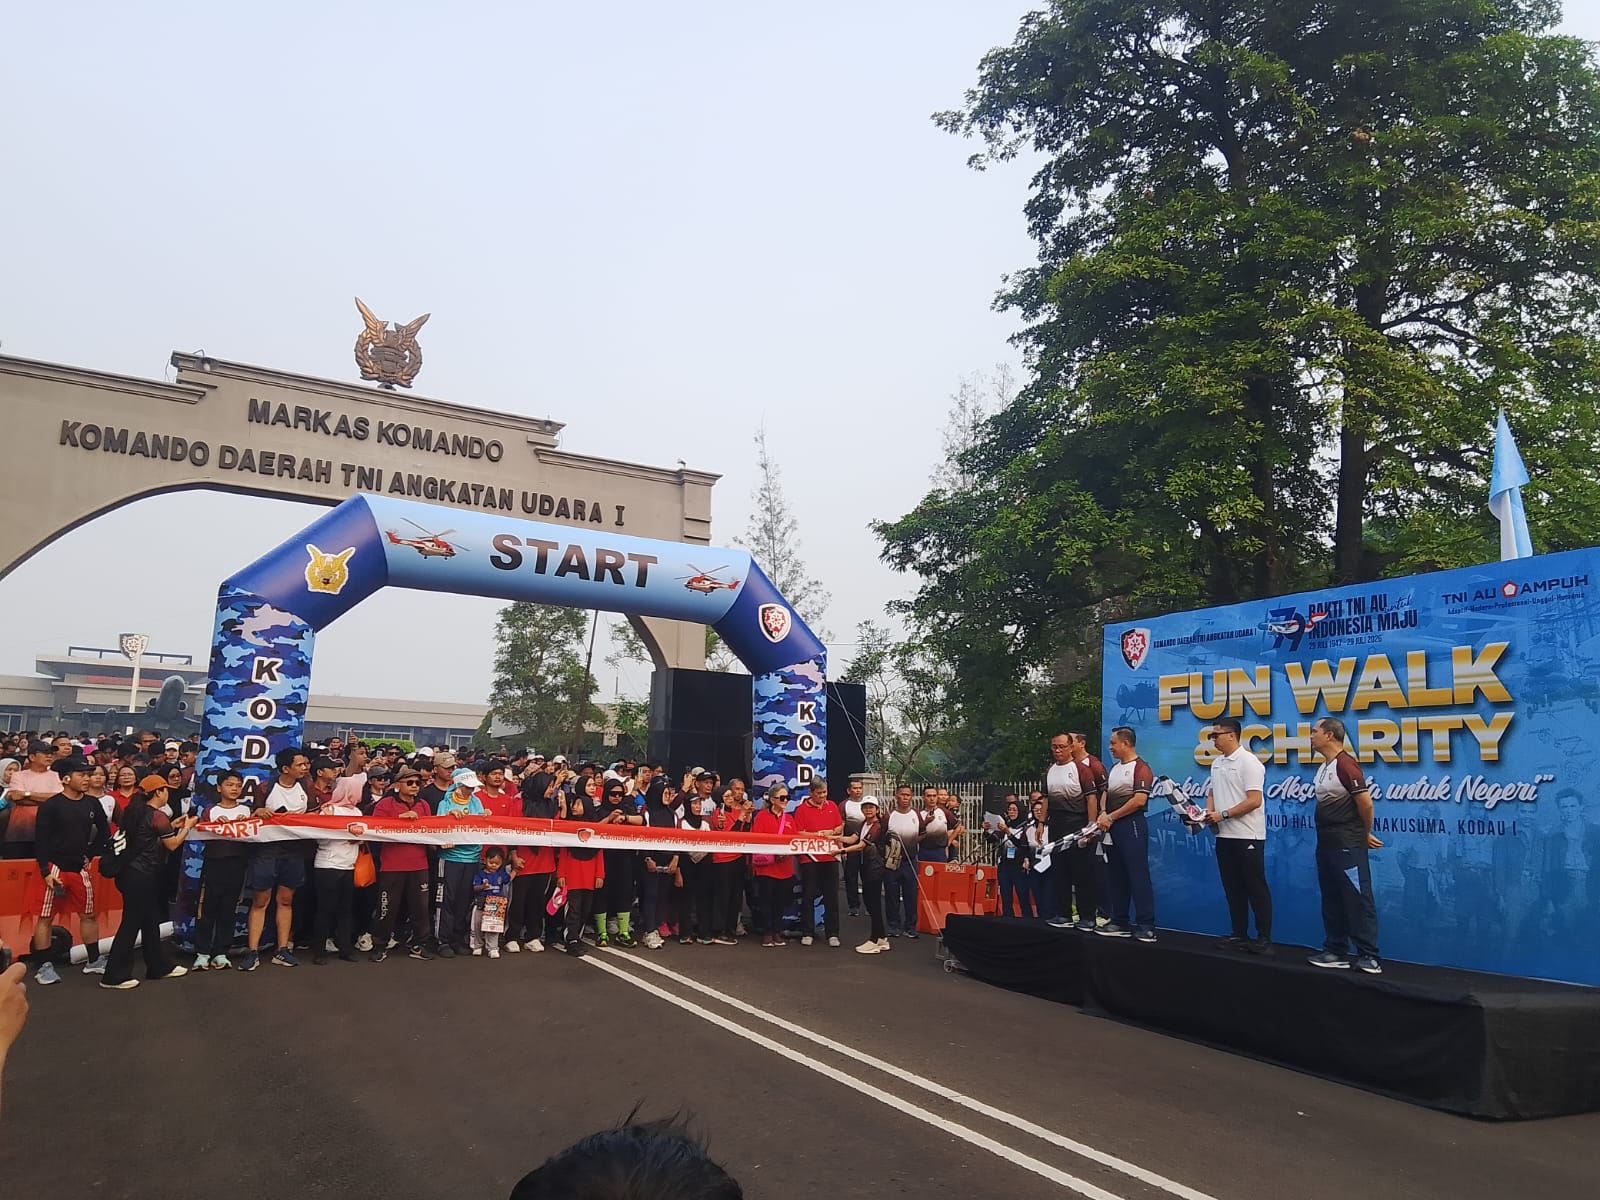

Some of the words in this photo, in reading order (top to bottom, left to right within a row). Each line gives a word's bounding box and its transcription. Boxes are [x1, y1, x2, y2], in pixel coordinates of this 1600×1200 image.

[248, 398, 369, 440] MARKAS
[376, 420, 504, 462] KOMANDO
[59, 419, 210, 467] KOMANDO
[218, 445, 332, 484] DAERAH
[341, 463, 382, 492] TNI
[388, 471, 514, 511] ANGKATAN
[521, 491, 603, 524] UDARA
[614, 504, 626, 526] I
[489, 533, 658, 588] START
[1441, 591, 1467, 605] TNI
[1473, 588, 1497, 601] AU
[1520, 574, 1589, 595] AMPUH
[1346, 597, 1366, 616] TNI
[1370, 593, 1388, 613] AU
[1308, 615, 1373, 640] INDONESIA
[1377, 609, 1418, 632] MAJU
[1158, 664, 1271, 722] FUN
[1284, 641, 1514, 714] WALK
[1386, 775, 1450, 801] untuk
[206, 818, 261, 838] TART
[375, 824, 418, 835] Komando
[420, 824, 453, 834] Daerah
[455, 824, 470, 833] TNI
[471, 825, 514, 836] Angkatan
[1458, 819, 1506, 836] KODAU
[790, 838, 832, 853] START
